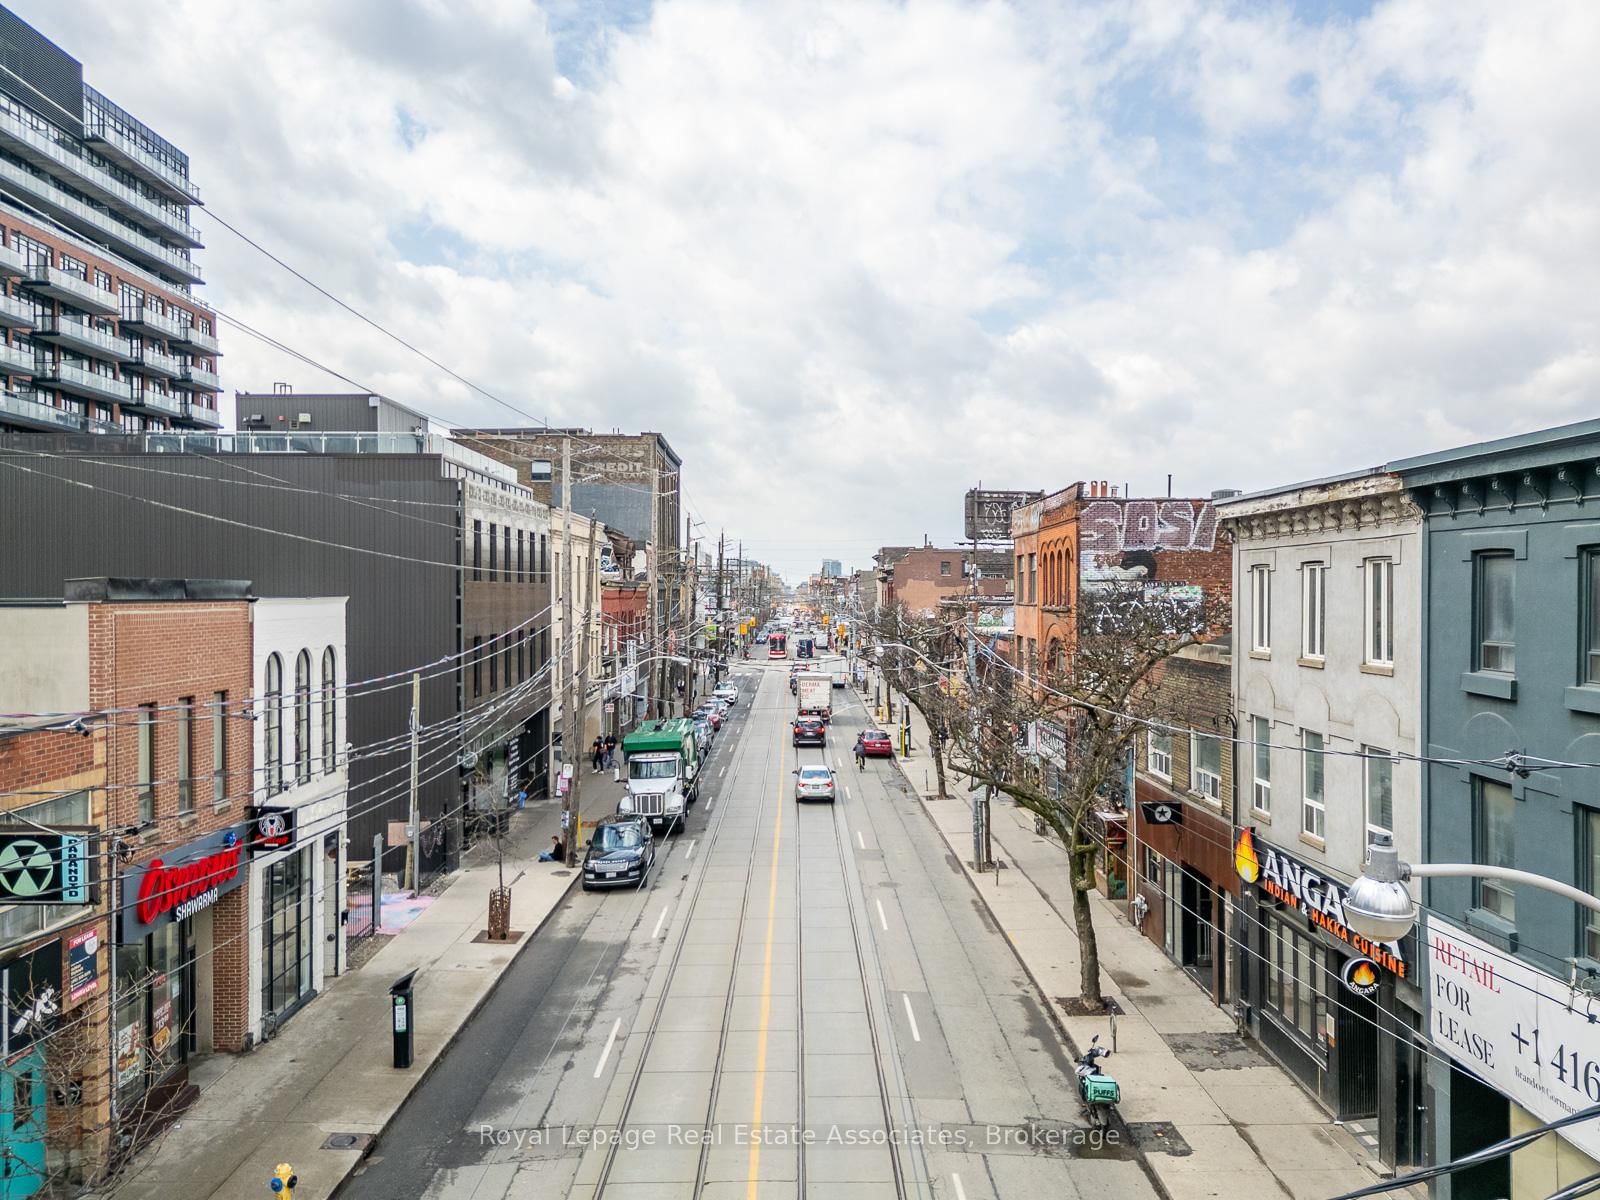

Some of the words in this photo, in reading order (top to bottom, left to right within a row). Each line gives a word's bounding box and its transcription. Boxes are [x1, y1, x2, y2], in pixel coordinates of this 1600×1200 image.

[68, 839, 79, 898] PARANOID
[176, 887, 219, 922] SHAWARMA
[1264, 879, 1298, 909] INDIAN
[1301, 902, 1308, 916] &
[1312, 909, 1348, 941] HAKKA
[1353, 935, 1408, 979] CUISINE
[1349, 981, 1380, 995] ANGARA
[1435, 936, 1502, 994] RETAIL
[1436, 973, 1472, 1017] FOR
[1438, 1010, 1495, 1070] LEASE
[1511, 1022, 1542, 1067] +1
[1550, 1044, 1600, 1102] 416
[1093, 1087, 1114, 1098] PUFFS
